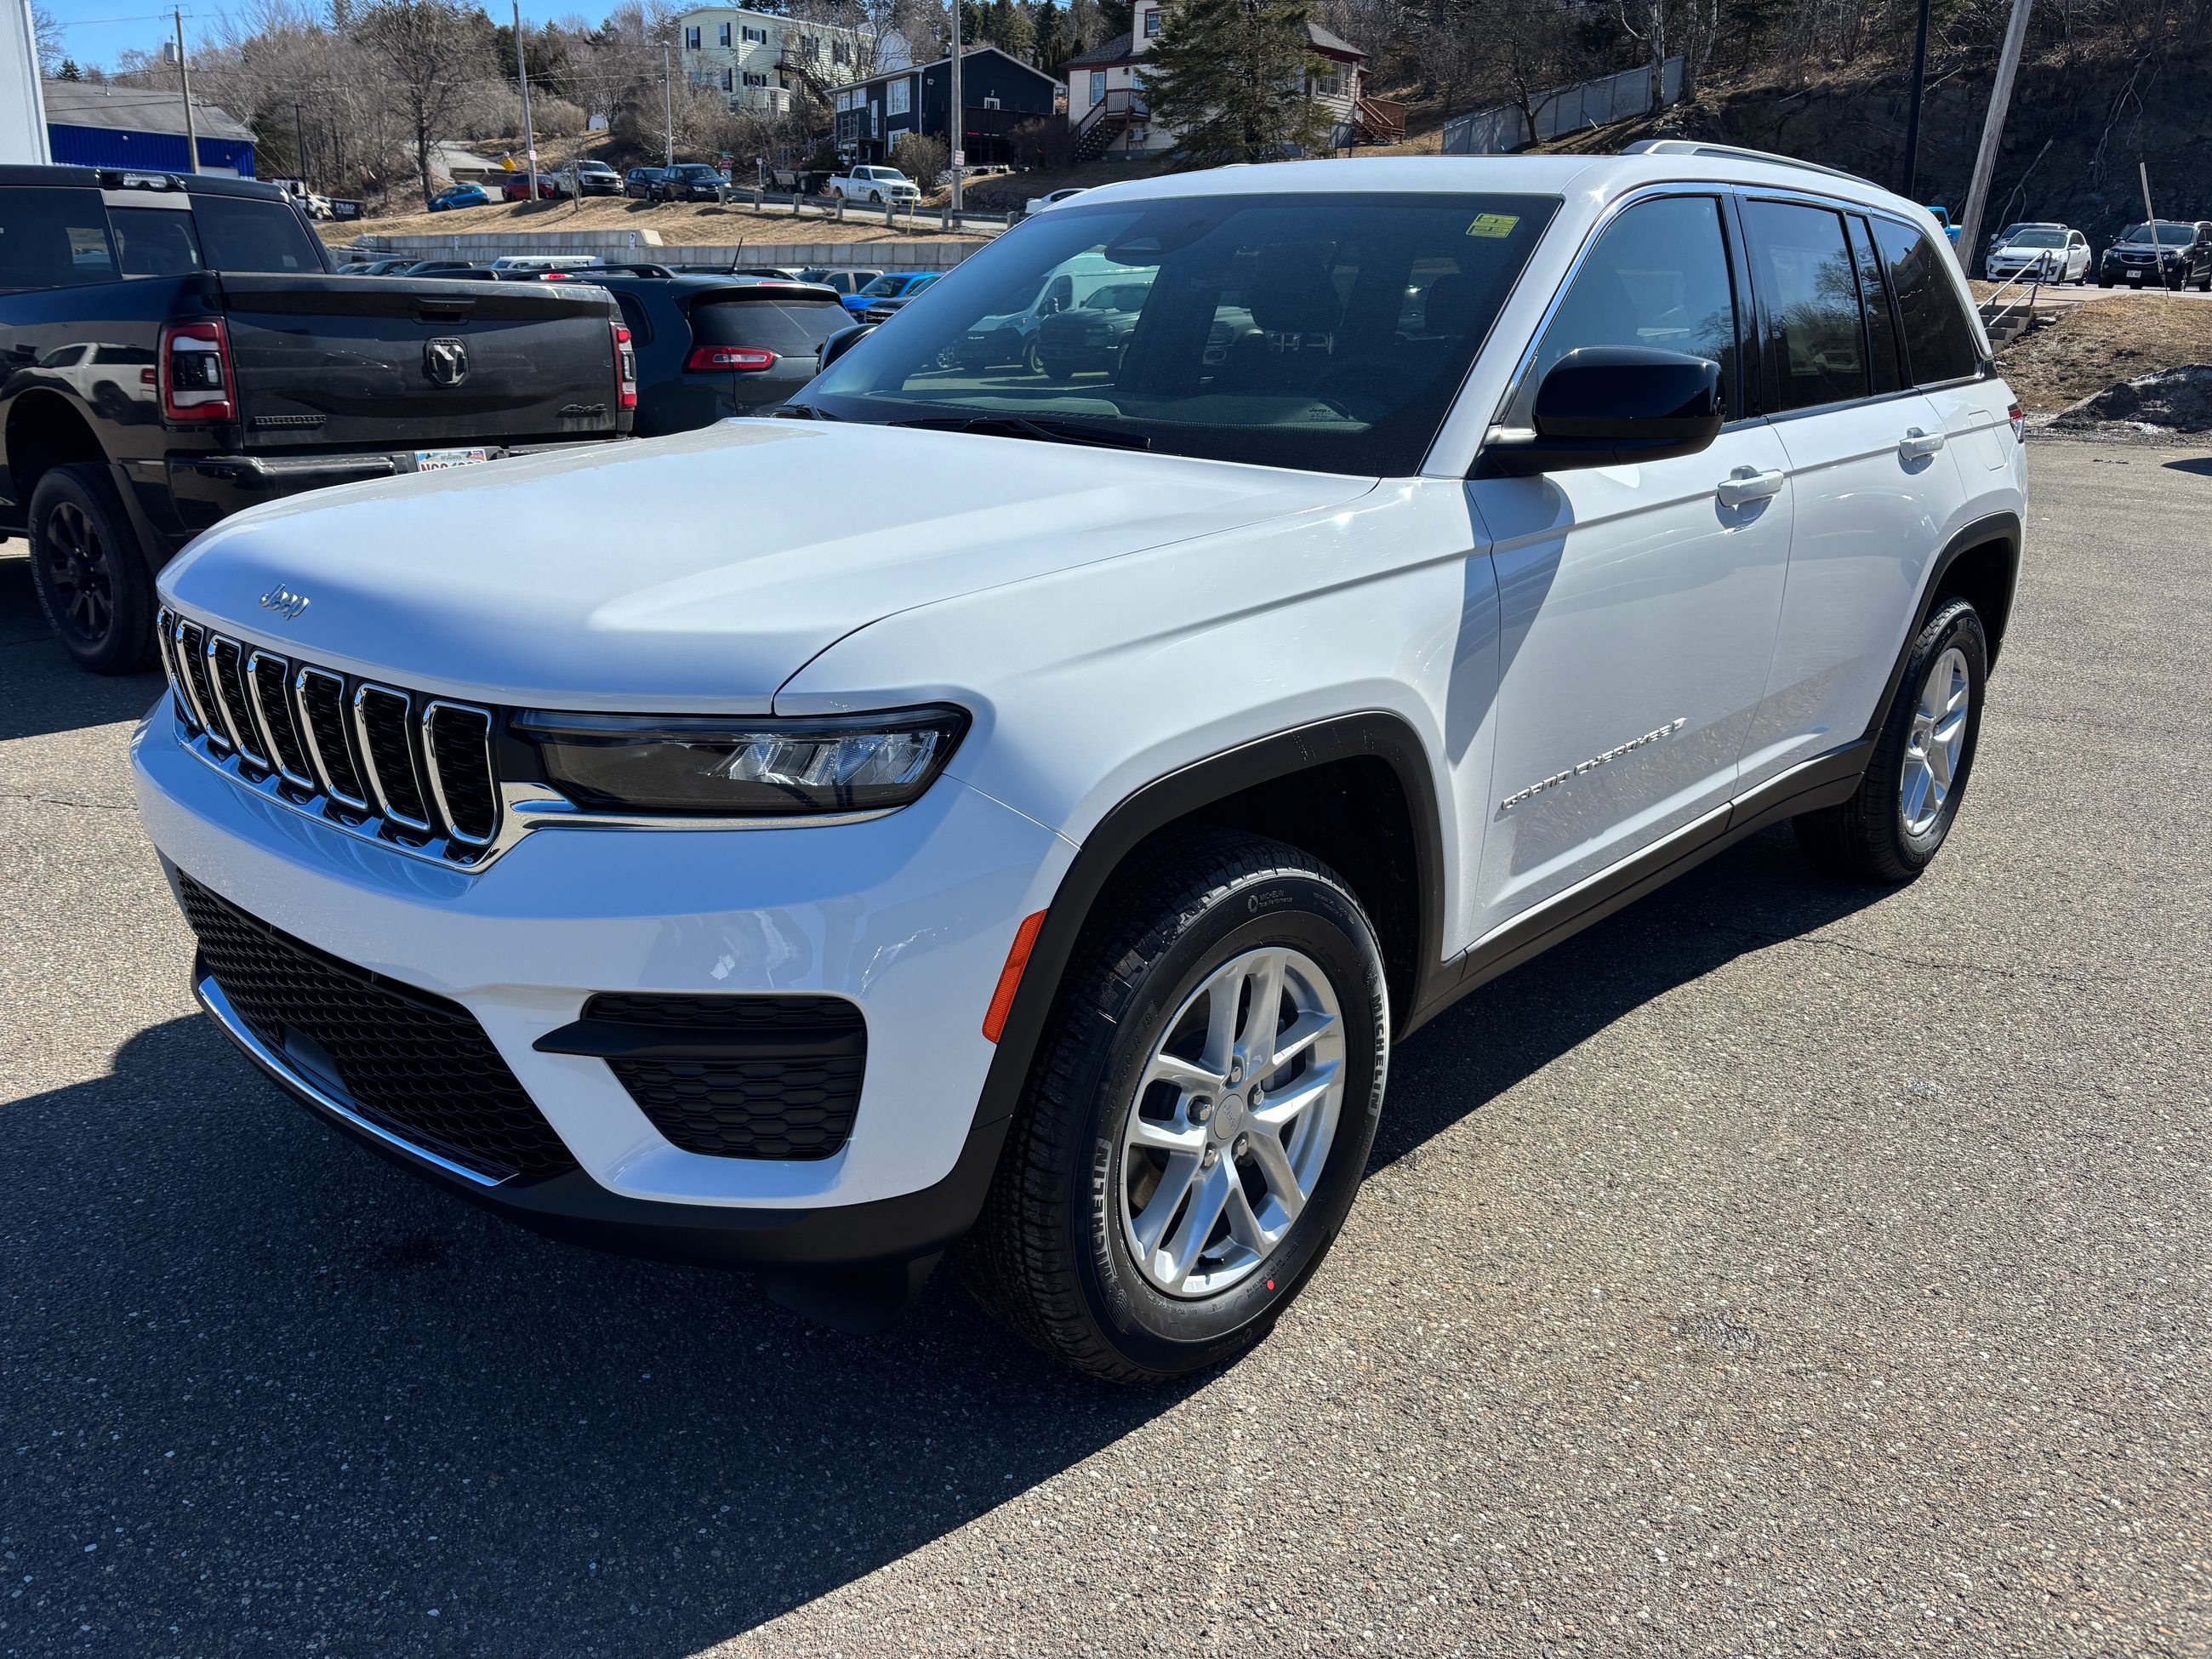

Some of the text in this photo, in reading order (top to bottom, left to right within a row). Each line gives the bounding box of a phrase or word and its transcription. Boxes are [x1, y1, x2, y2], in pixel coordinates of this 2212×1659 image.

[259, 583, 310, 621] Jeep
[1501, 724, 1673, 811] GRAND CHEROKEE
[1259, 889, 1285, 901] MICHELIN
[1370, 993, 1385, 1110] MICHELIN
[1223, 1104, 1237, 1132] Jeep
[1091, 1146, 1113, 1285] MICHELIN
